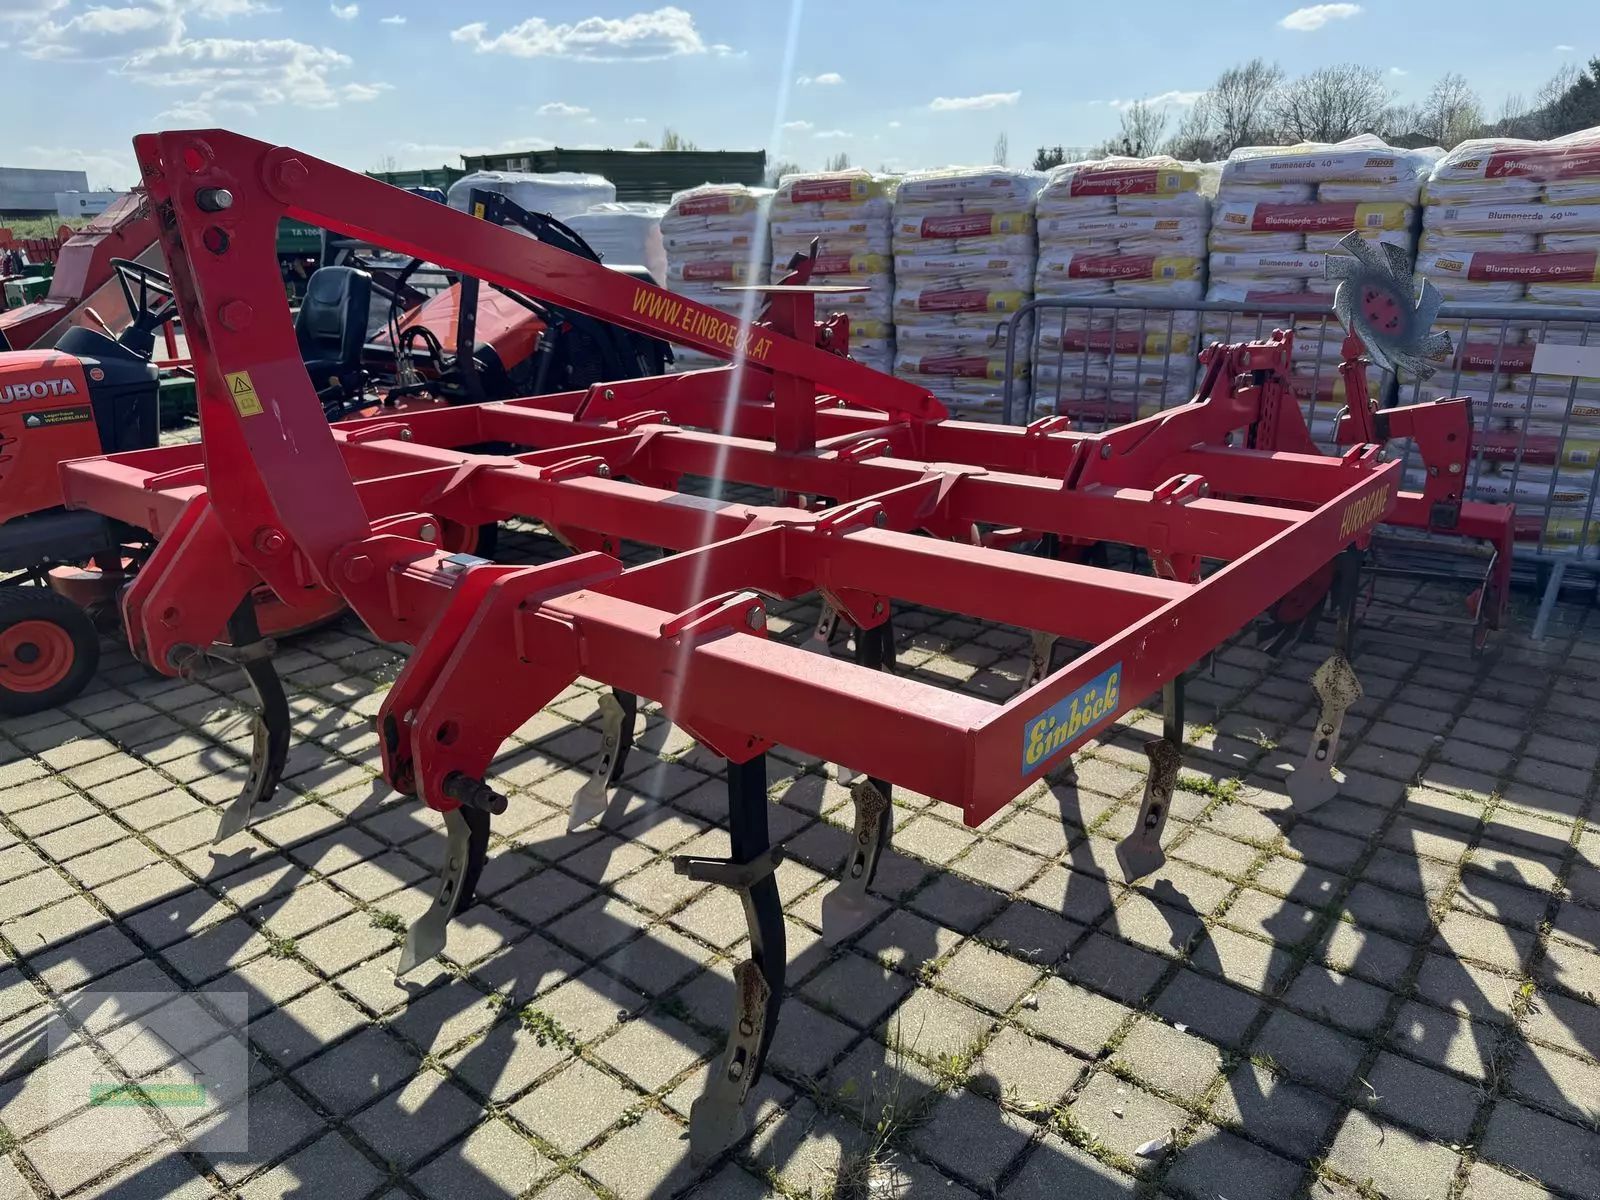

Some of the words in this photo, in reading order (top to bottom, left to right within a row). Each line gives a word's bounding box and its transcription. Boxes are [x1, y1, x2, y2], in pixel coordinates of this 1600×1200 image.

[1270, 159, 1316, 169] Blumenerde
[1321, 160, 1332, 168] 40
[1365, 158, 1394, 166] impos
[1265, 216, 1311, 225] Blumenerde
[1316, 217, 1327, 225] 40
[1488, 211, 1544, 221] Blumenerde
[1550, 212, 1563, 220] 40
[1258, 258, 1304, 268] Blumenerde
[1485, 264, 1541, 274] Blumenerde
[1548, 266, 1561, 275] 40
[633, 287, 773, 361] WWW.EINBOECK.AT
[0, 379, 78, 404] UBOTA
[1339, 483, 1390, 542] HURRICANE
[1026, 672, 1118, 765] Einböck
